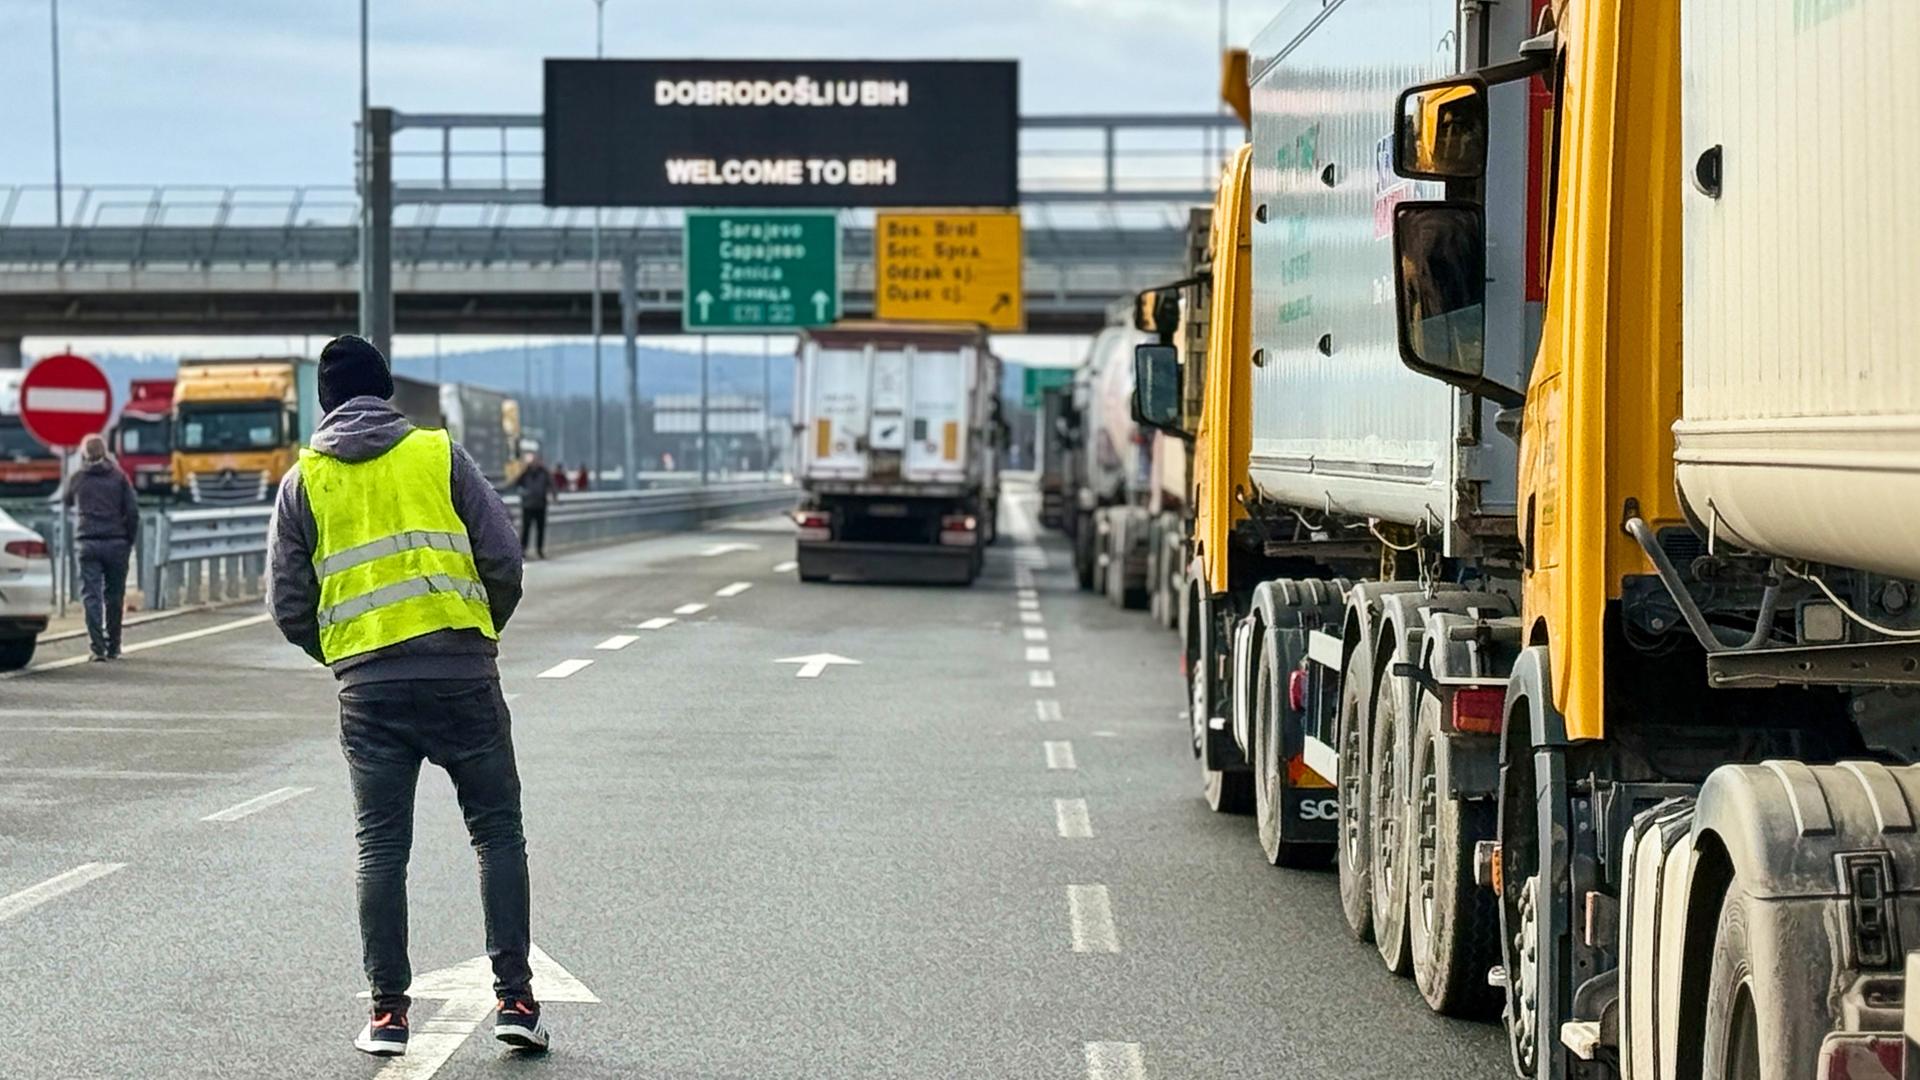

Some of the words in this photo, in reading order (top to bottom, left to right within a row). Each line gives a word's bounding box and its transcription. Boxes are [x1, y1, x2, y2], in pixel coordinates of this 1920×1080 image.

[655, 76, 834, 106] DOBRODOŠLI
[837, 80, 859, 106] U
[861, 80, 909, 106] BIH
[665, 158, 803, 185] WELCOME
[806, 158, 846, 185] TO
[848, 158, 896, 185] BIH
[720, 219, 803, 242] Sarajevo
[934, 220, 977, 238] Brod
[720, 262, 783, 282] Zenica
